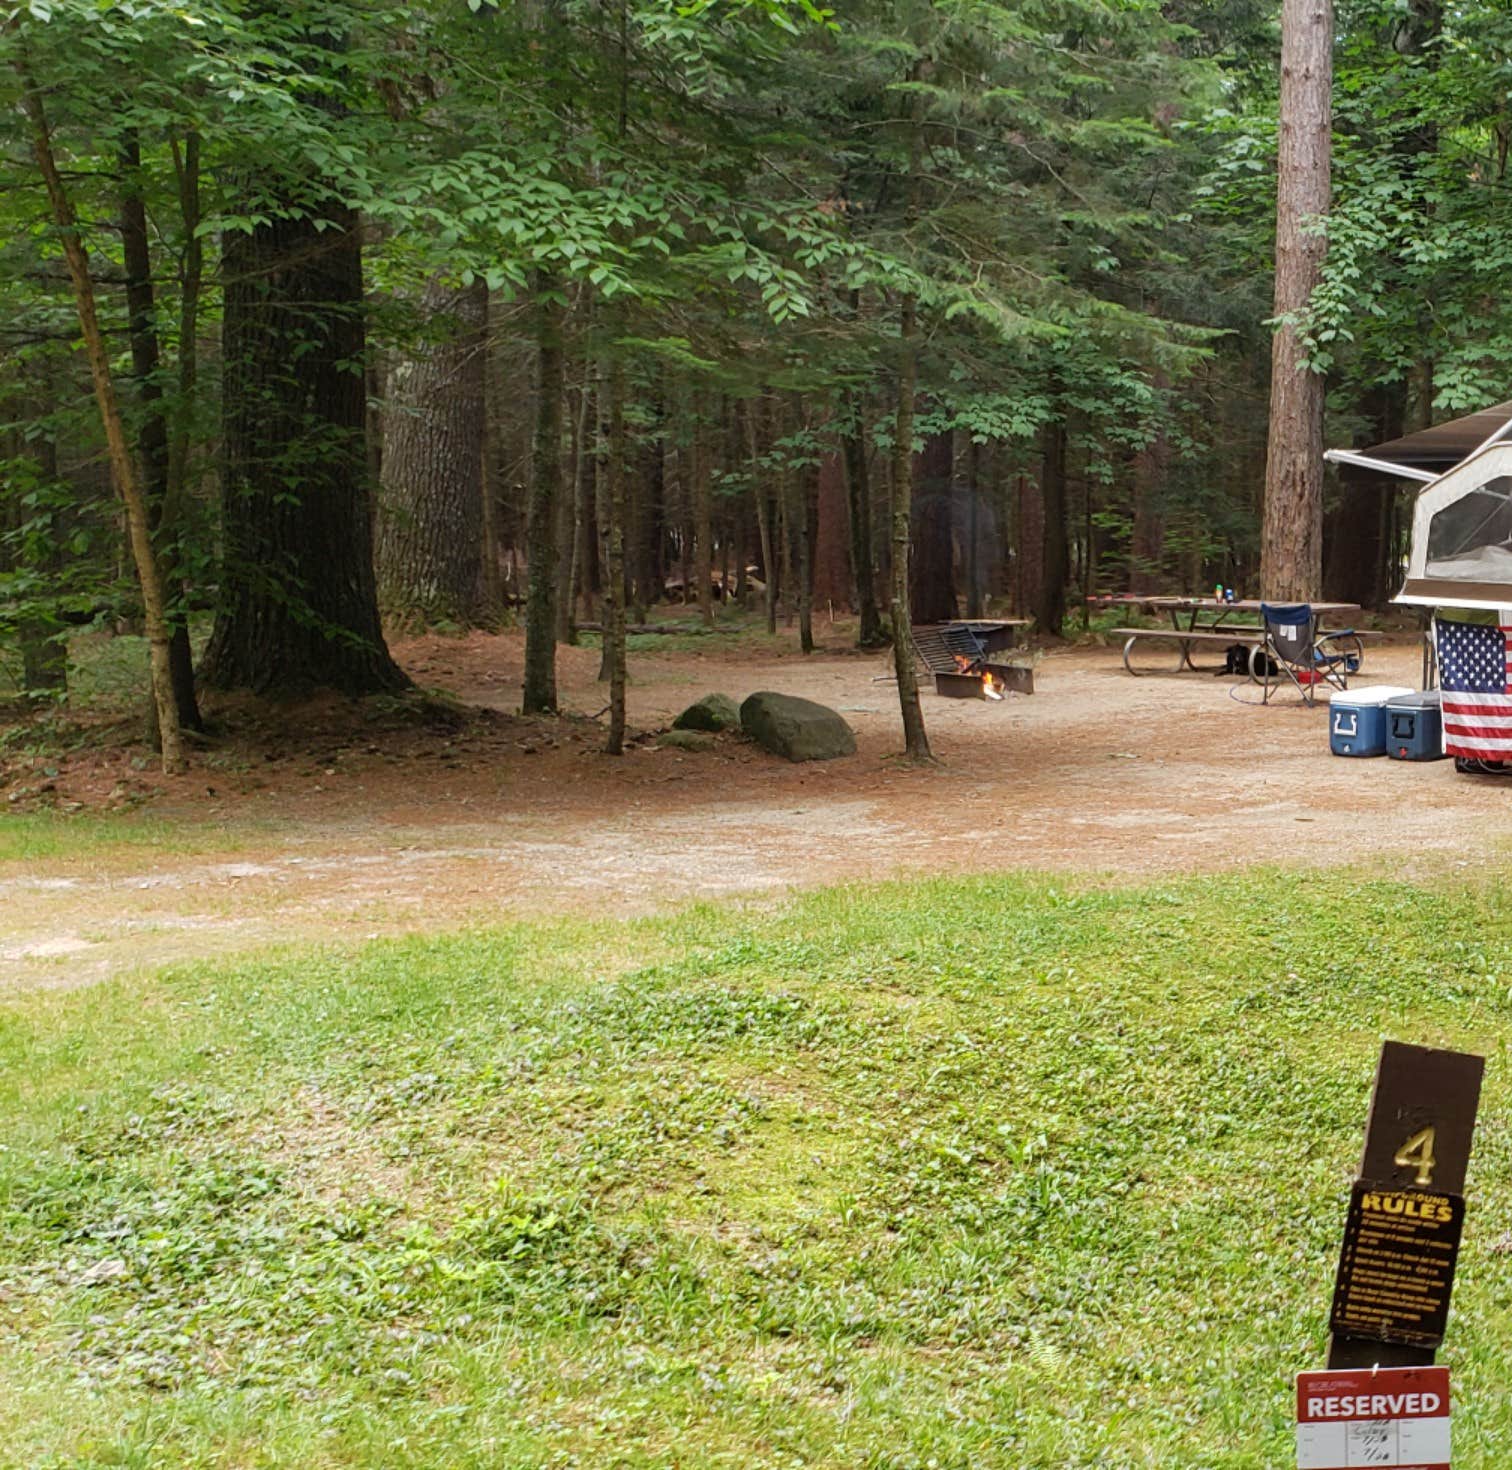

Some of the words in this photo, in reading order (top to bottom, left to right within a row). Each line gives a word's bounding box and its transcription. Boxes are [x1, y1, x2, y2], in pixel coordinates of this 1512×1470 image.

[1394, 1126, 1436, 1185] 4
[1361, 1193, 1453, 1222] RULES
[1307, 1393, 1440, 1418] RESERVED
